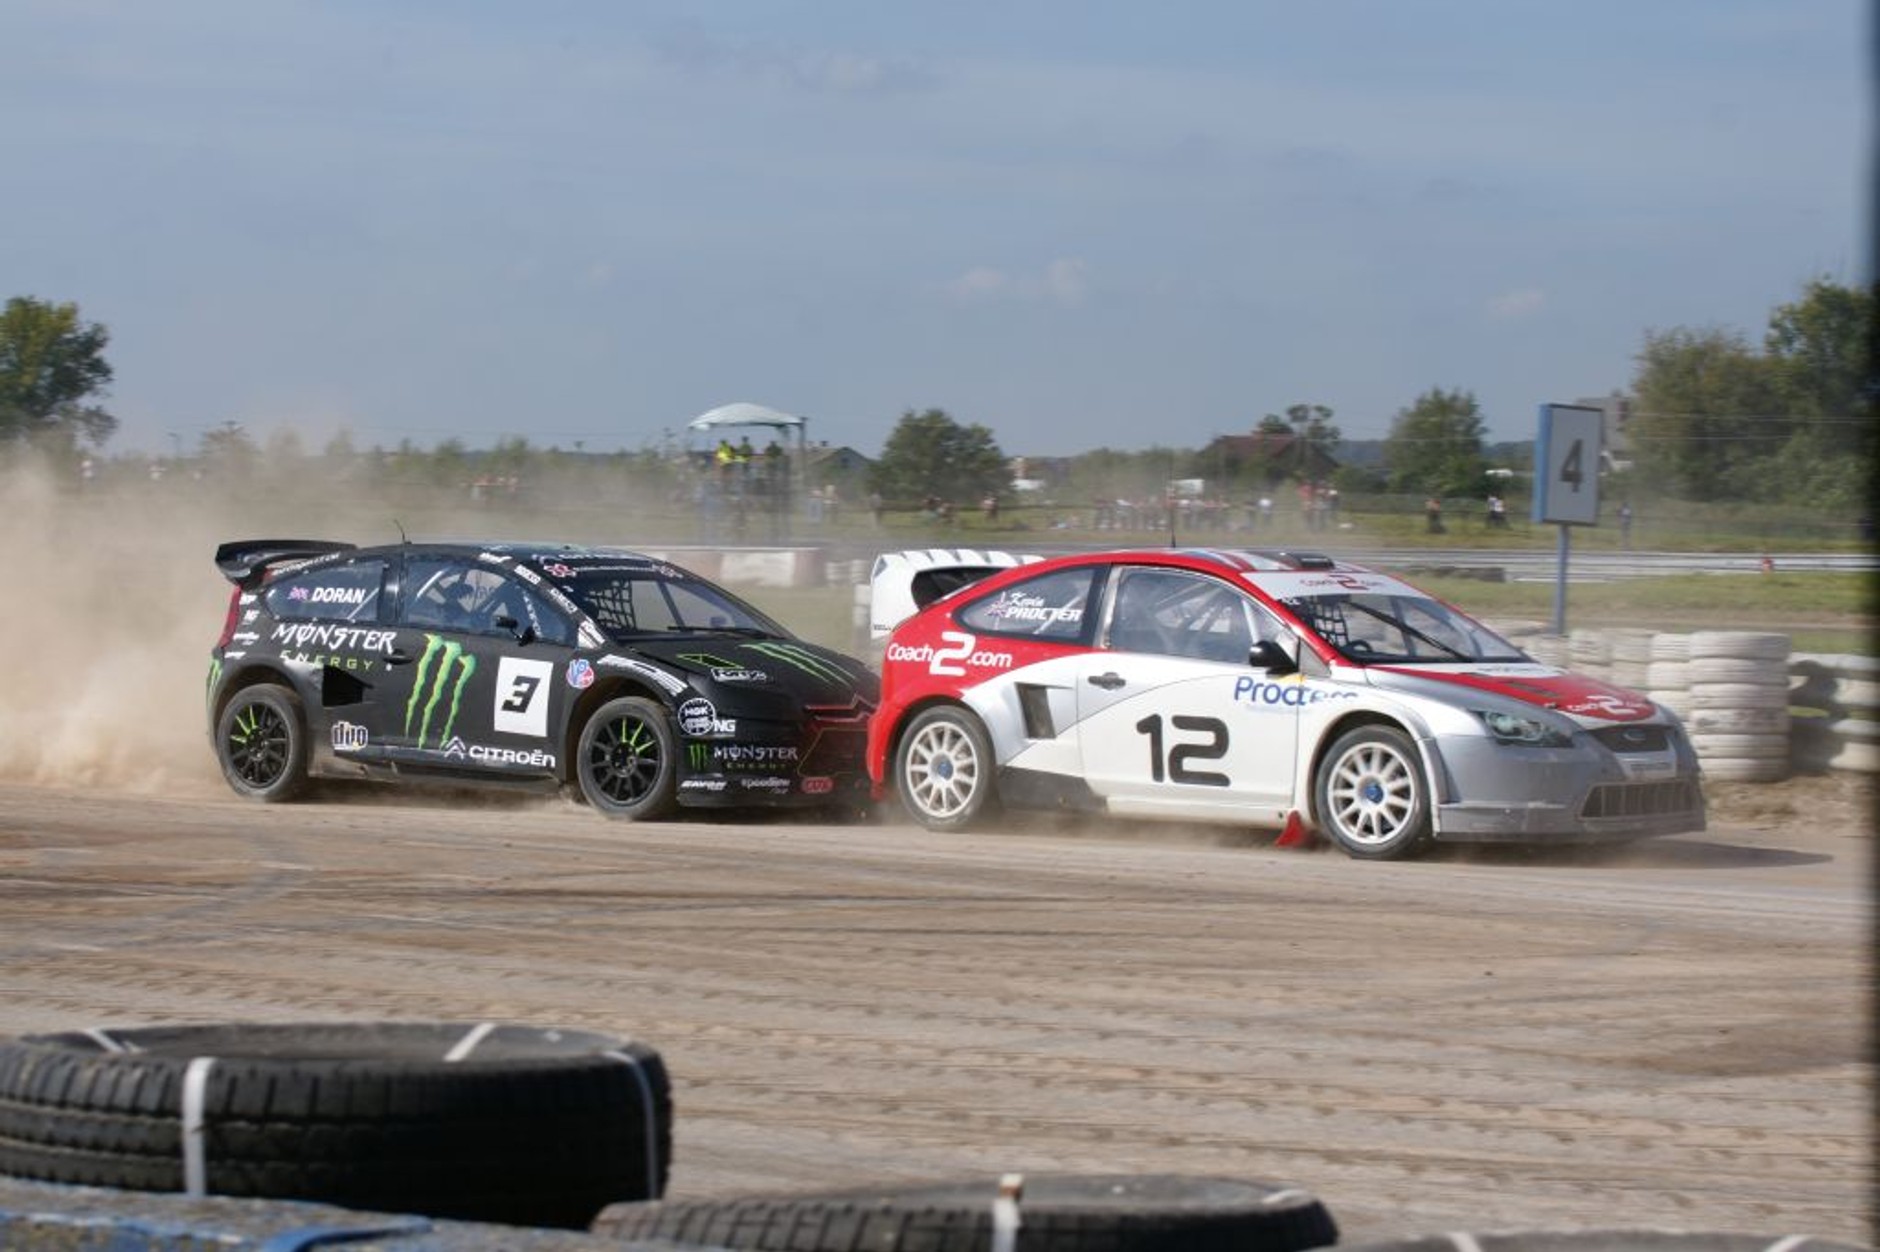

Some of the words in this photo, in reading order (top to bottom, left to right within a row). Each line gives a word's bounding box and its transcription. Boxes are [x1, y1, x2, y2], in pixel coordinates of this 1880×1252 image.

[1560, 438, 1583, 493] 4
[312, 587, 366, 603] DORAN
[1004, 607, 1082, 622] PROCTER
[279, 650, 374, 670] ENERGY
[501, 675, 541, 713] 3
[1136, 713, 1231, 787] 12
